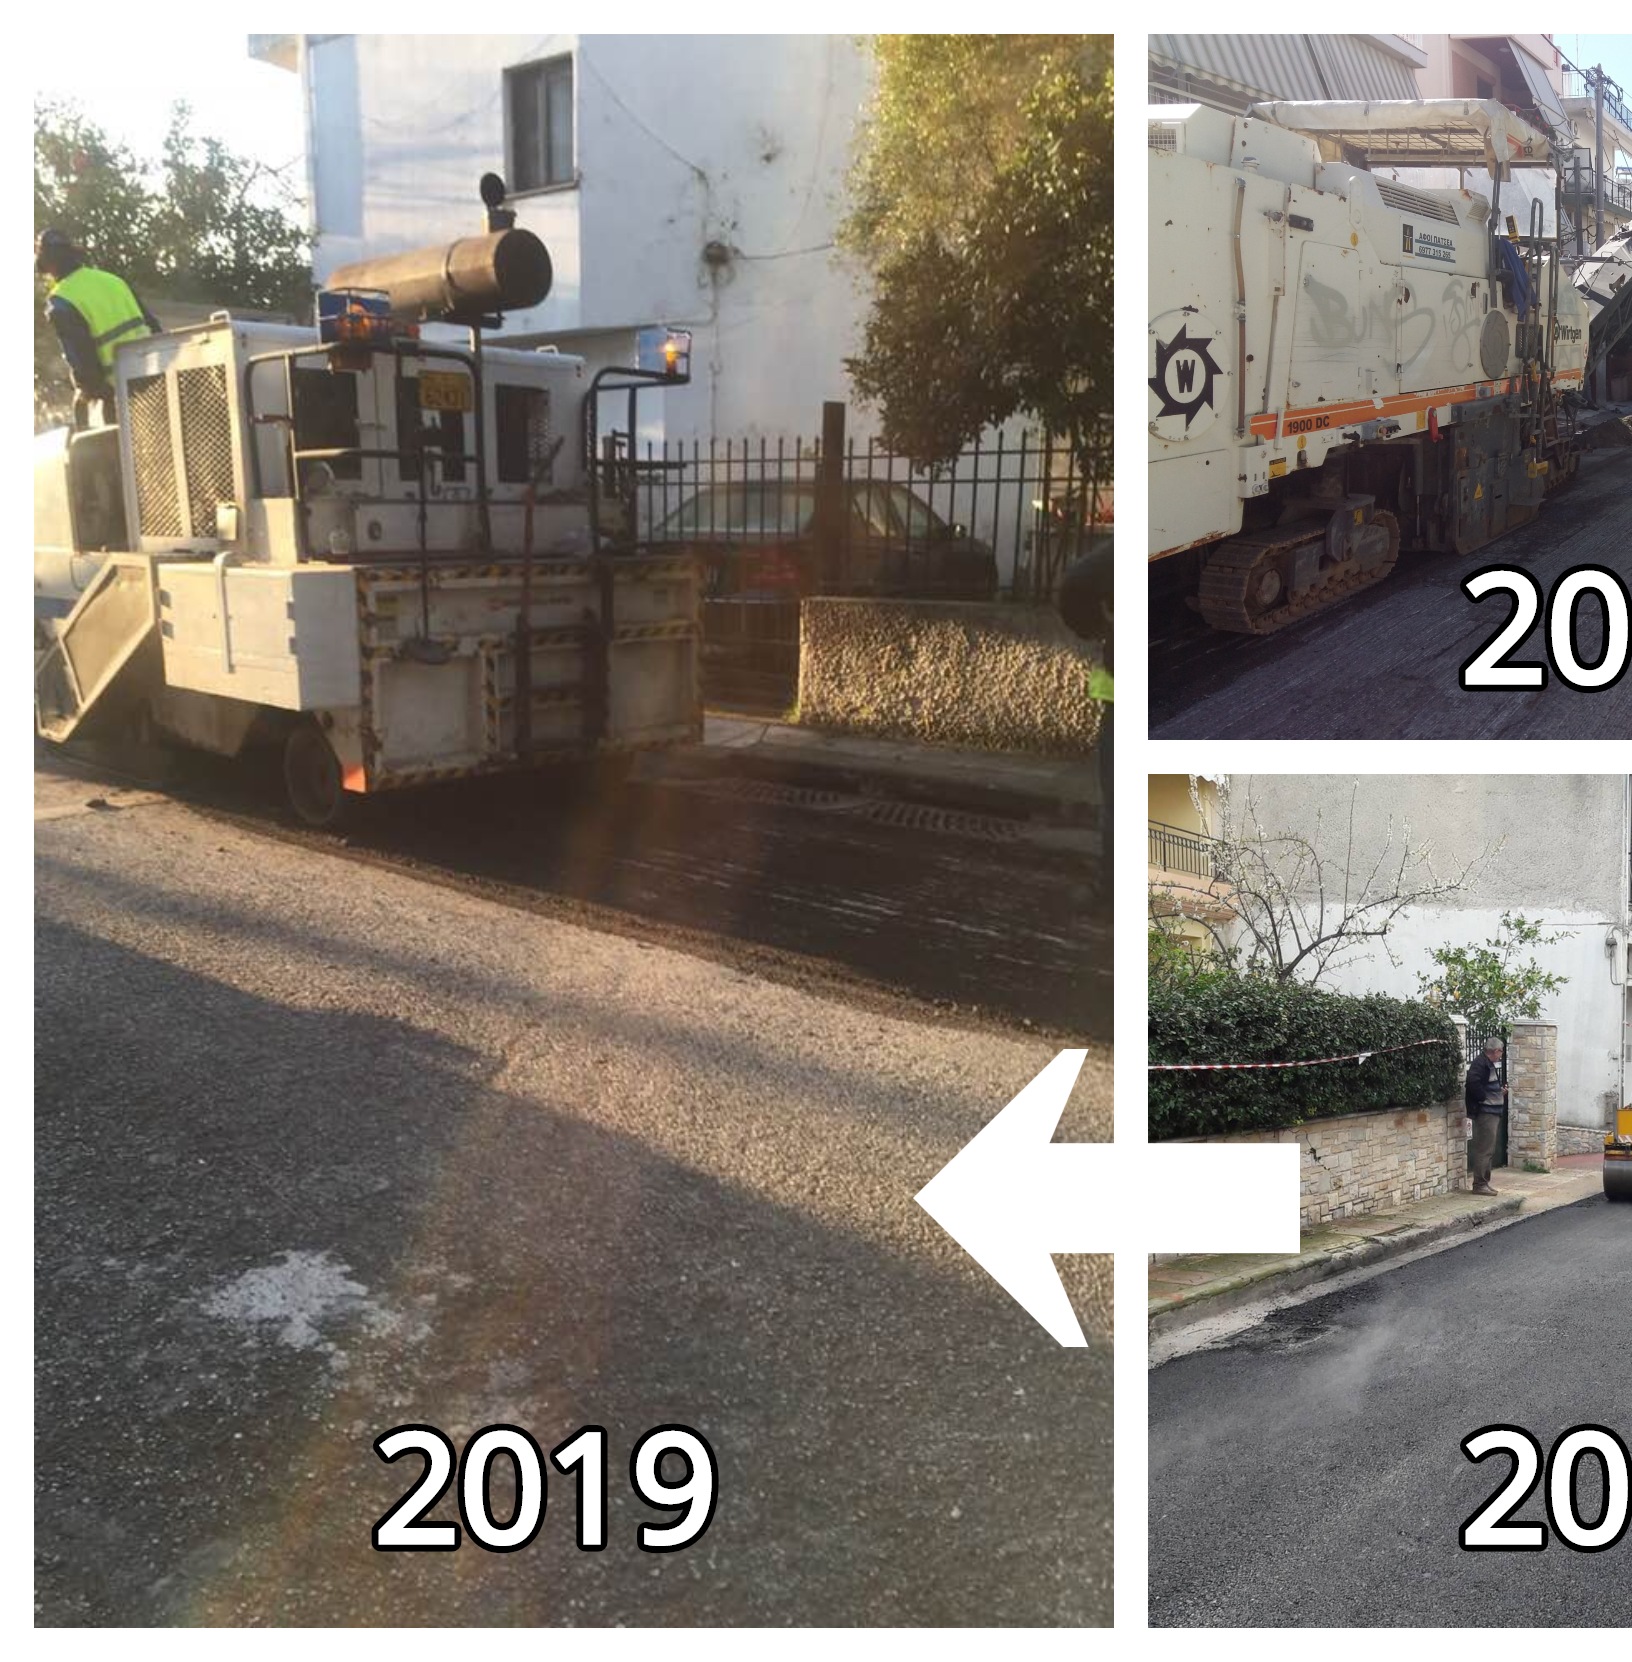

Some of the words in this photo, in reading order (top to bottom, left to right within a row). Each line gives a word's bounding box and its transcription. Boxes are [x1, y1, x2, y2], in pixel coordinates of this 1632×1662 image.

[1175, 359, 1196, 394] W
[1287, 419, 1313, 435] 1900
[1315, 416, 1330, 430] DC
